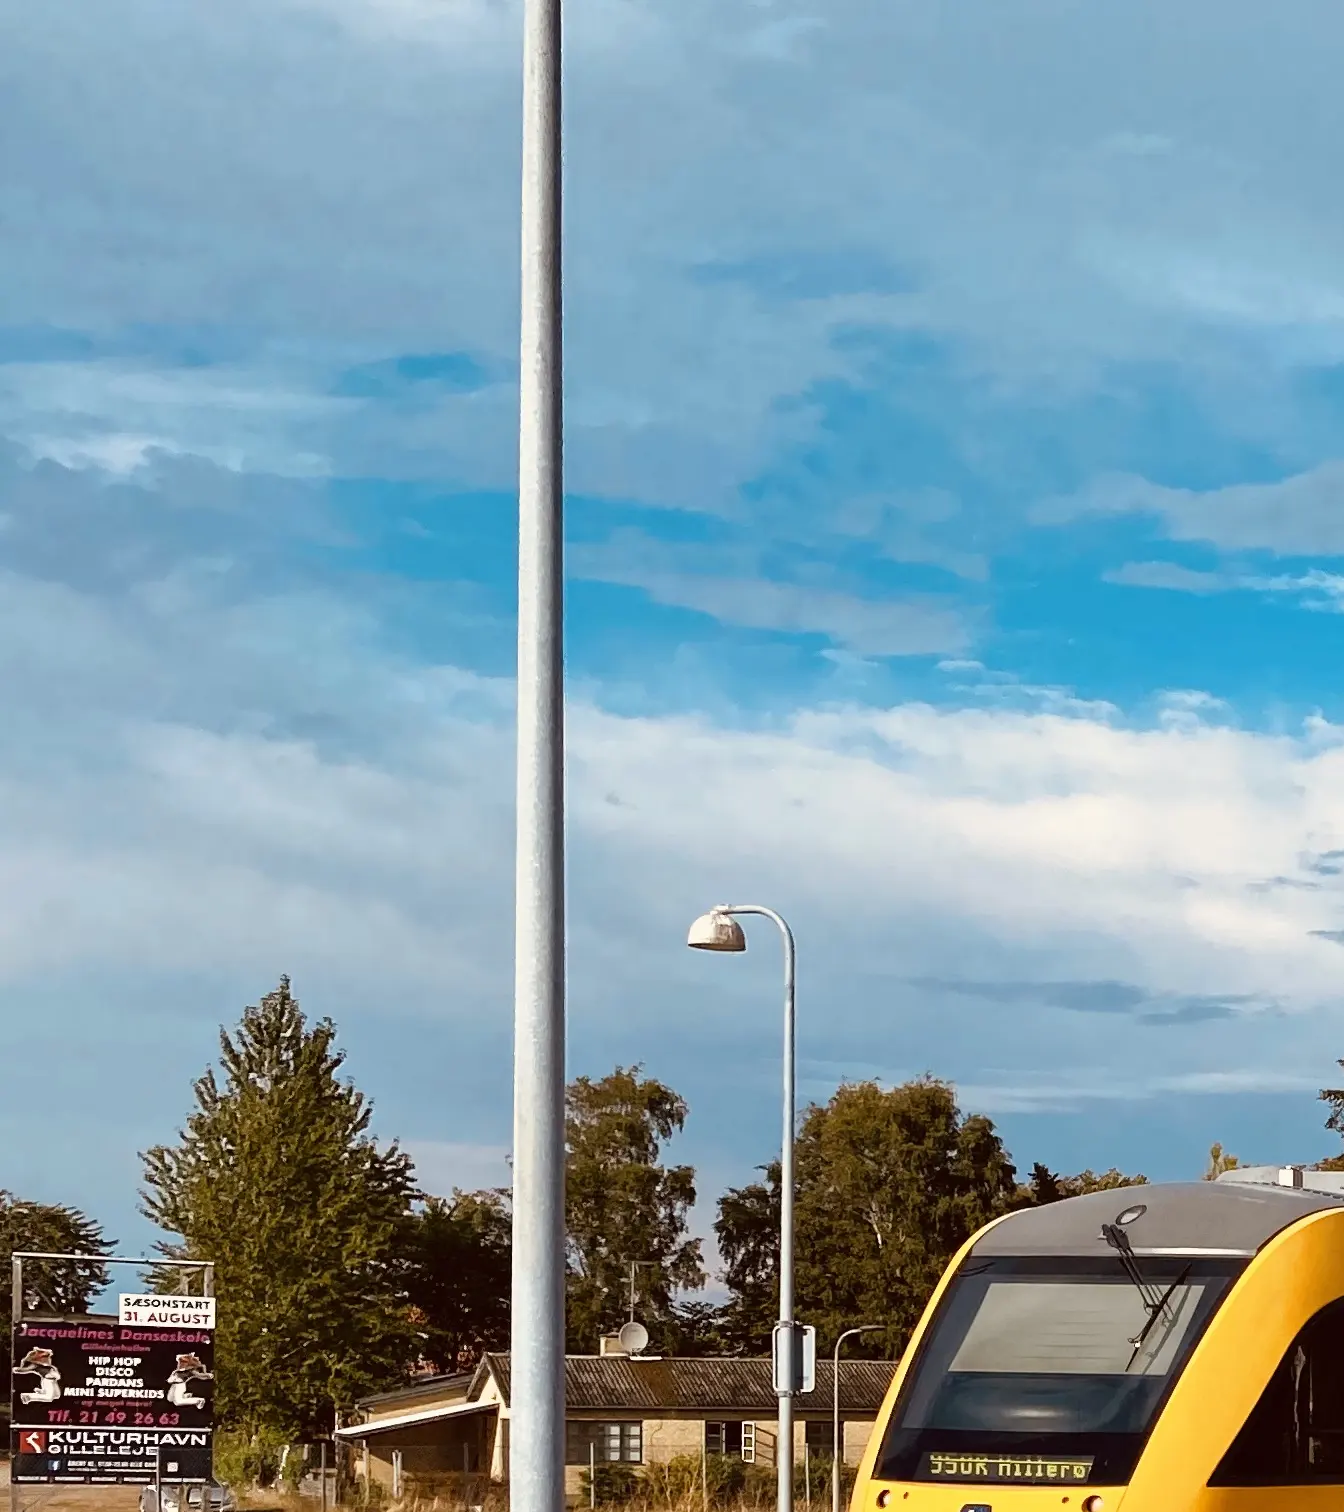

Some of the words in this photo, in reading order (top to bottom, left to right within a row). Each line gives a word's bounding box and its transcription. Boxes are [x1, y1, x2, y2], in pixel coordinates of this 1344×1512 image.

[123, 1297, 211, 1310] SÆSONSTART
[123, 1311, 143, 1323] 31.
[147, 1312, 212, 1325] AUGUST
[18, 1326, 115, 1340] Jacquelines
[120, 1329, 211, 1343] Danseskole
[88, 1356, 111, 1366] HIP
[113, 1356, 142, 1367] HOP
[95, 1366, 135, 1377] DISCO
[85, 1377, 144, 1388] PARDANS
[63, 1387, 95, 1398] MINI
[97, 1388, 165, 1400] SUPERKIDS
[79, 1410, 98, 1424] 21
[104, 1410, 127, 1424] 49
[134, 1411, 154, 1425] 26
[158, 1412, 180, 1426] 63
[48, 1431, 207, 1446] KULTURHAVN
[47, 1445, 159, 1456] GILLELEJE
